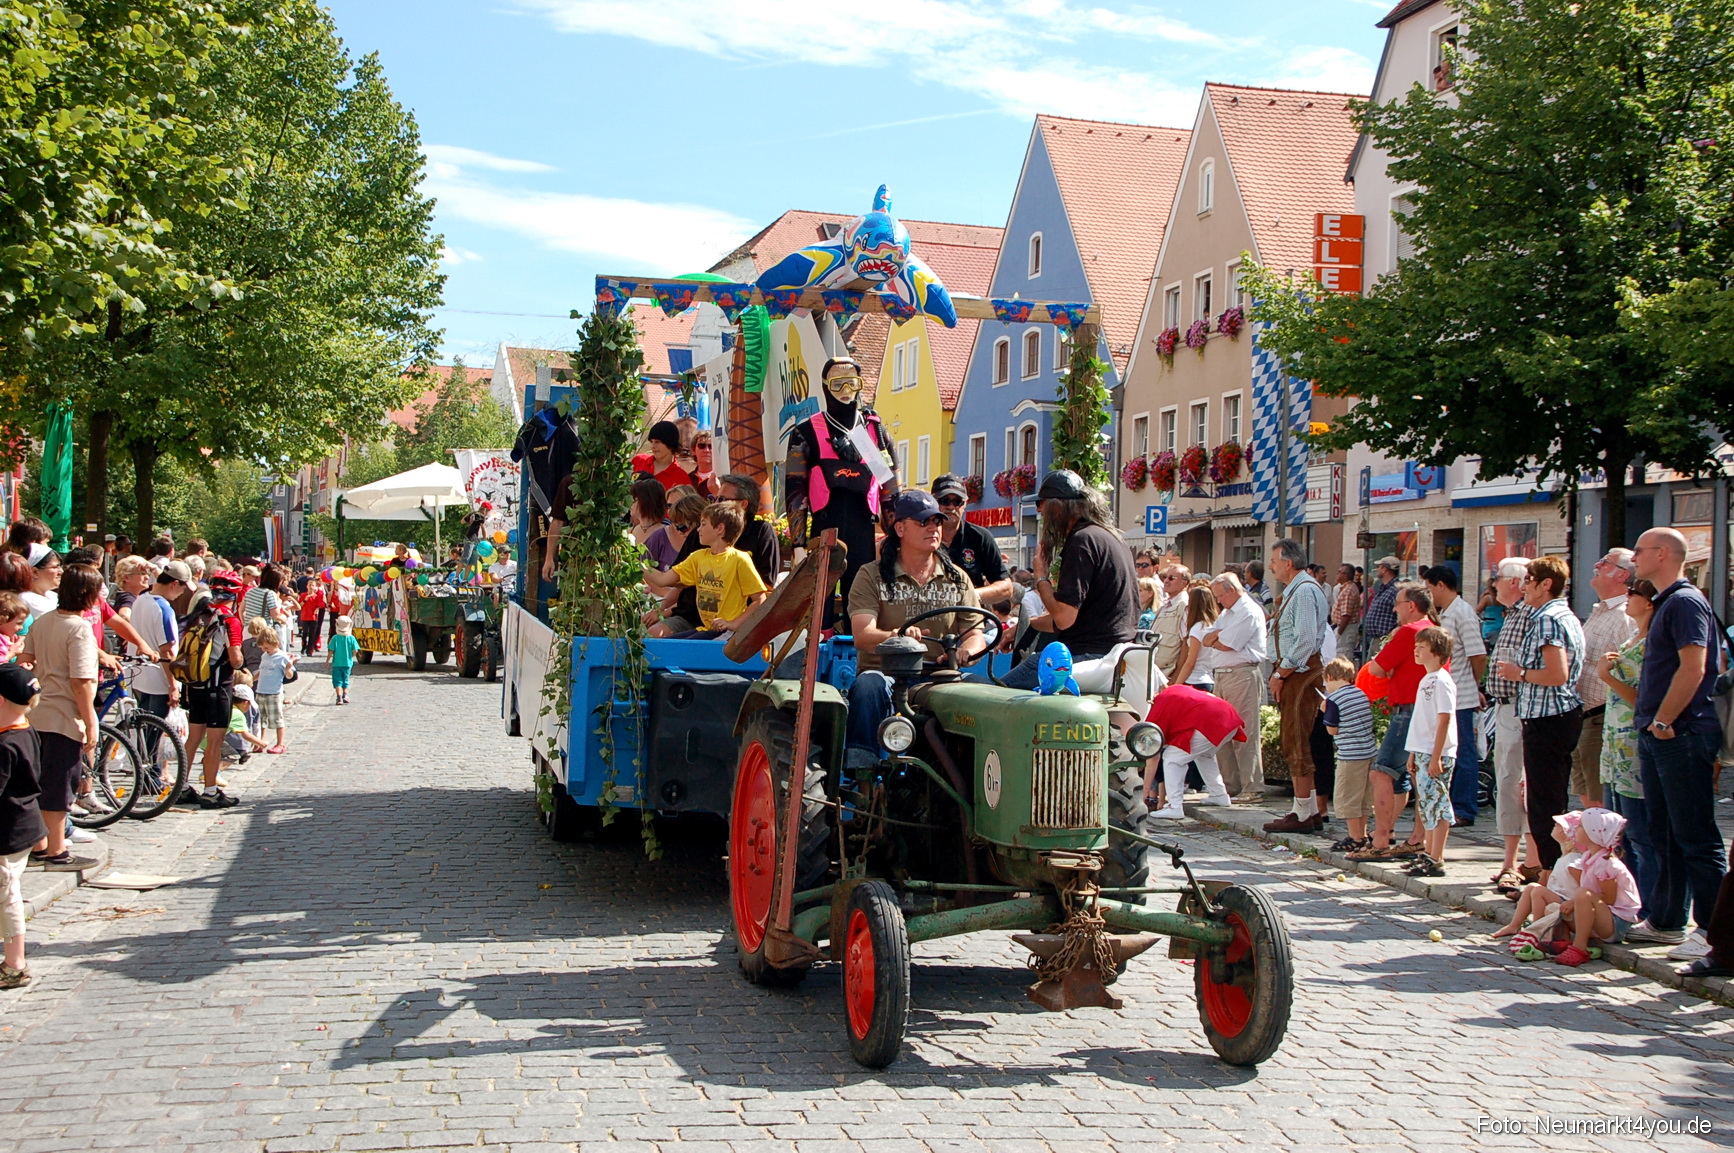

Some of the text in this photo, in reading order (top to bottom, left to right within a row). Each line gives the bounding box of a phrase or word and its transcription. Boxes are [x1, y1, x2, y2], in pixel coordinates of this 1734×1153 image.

[1332, 466, 1341, 519] KINO
[1150, 508, 1163, 531] P
[1039, 723, 1103, 741] FENDT
[987, 764, 992, 792] 6
